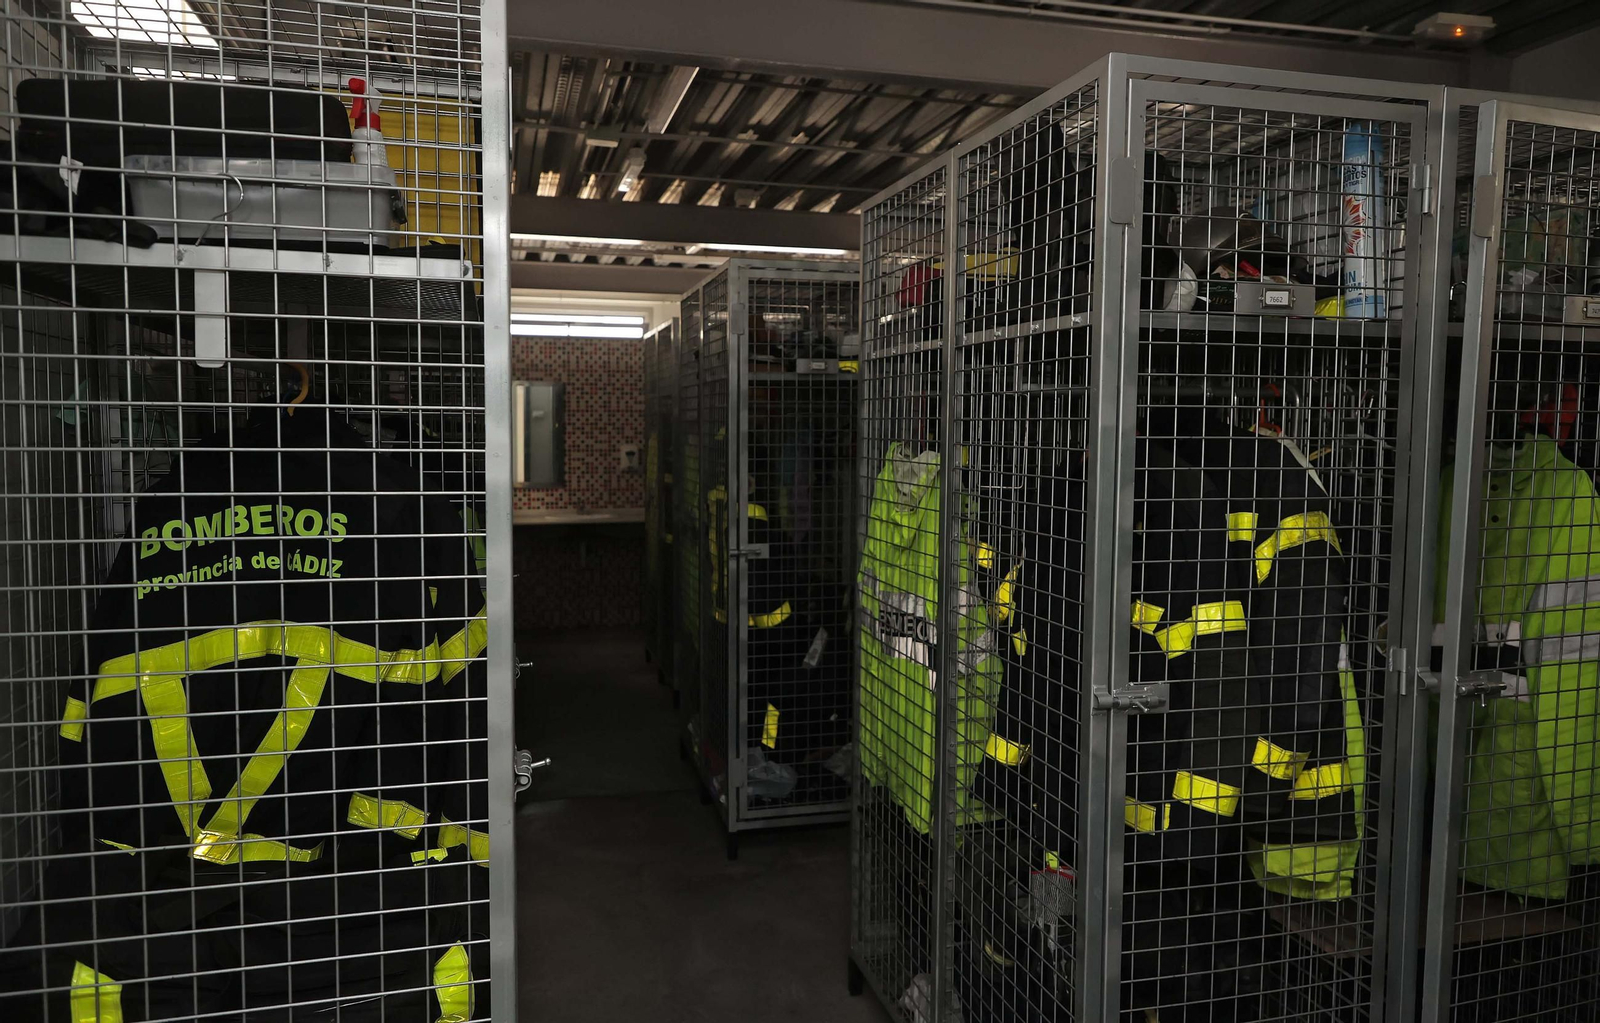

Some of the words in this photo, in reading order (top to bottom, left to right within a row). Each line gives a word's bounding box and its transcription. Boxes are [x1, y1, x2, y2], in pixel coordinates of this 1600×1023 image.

[140, 504, 348, 560] BOMBEROS
[137, 554, 243, 600] provincia
[250, 551, 281, 570] de
[286, 549, 343, 578] CÁDIZ
